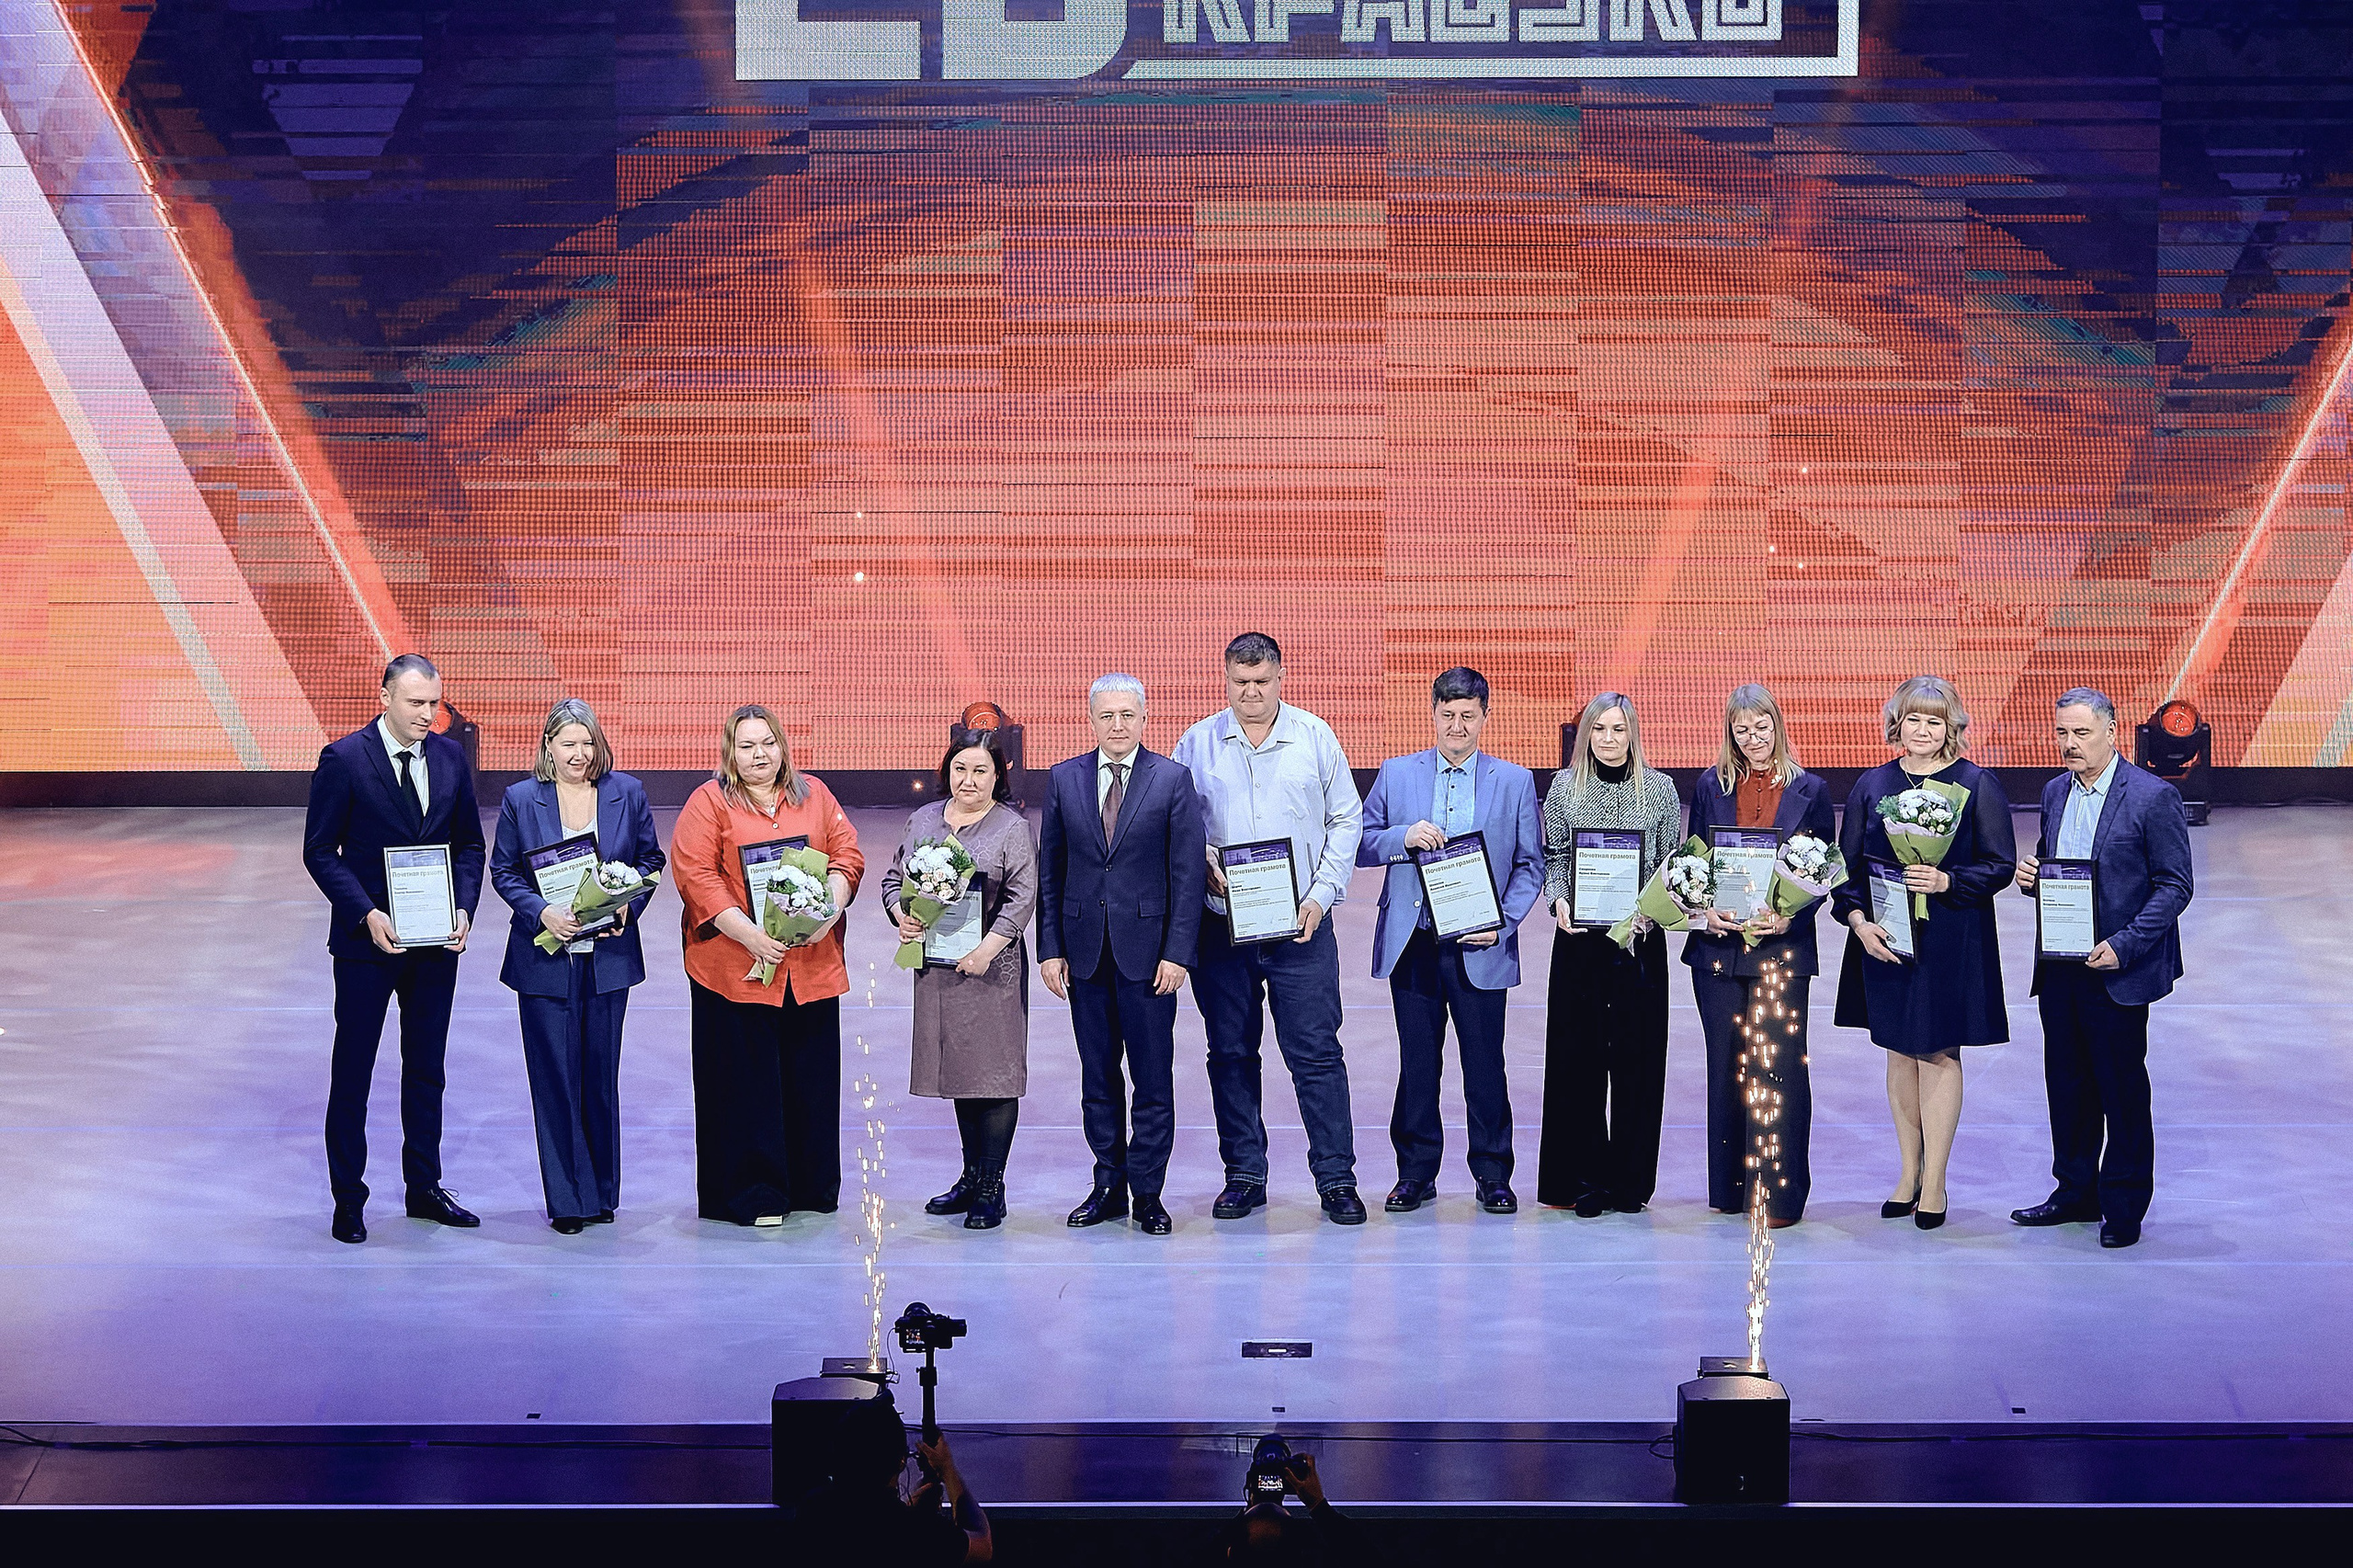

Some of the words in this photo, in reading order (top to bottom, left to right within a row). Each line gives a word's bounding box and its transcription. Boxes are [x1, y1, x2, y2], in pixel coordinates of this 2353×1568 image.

[1578, 851, 1609, 859] Почетная
[1609, 853, 1636, 861] грамота
[1229, 866, 1260, 876] Почетная
[1260, 862, 1287, 873] грамота
[1425, 863, 1455, 876] Почетная
[1455, 856, 1482, 869] грамота
